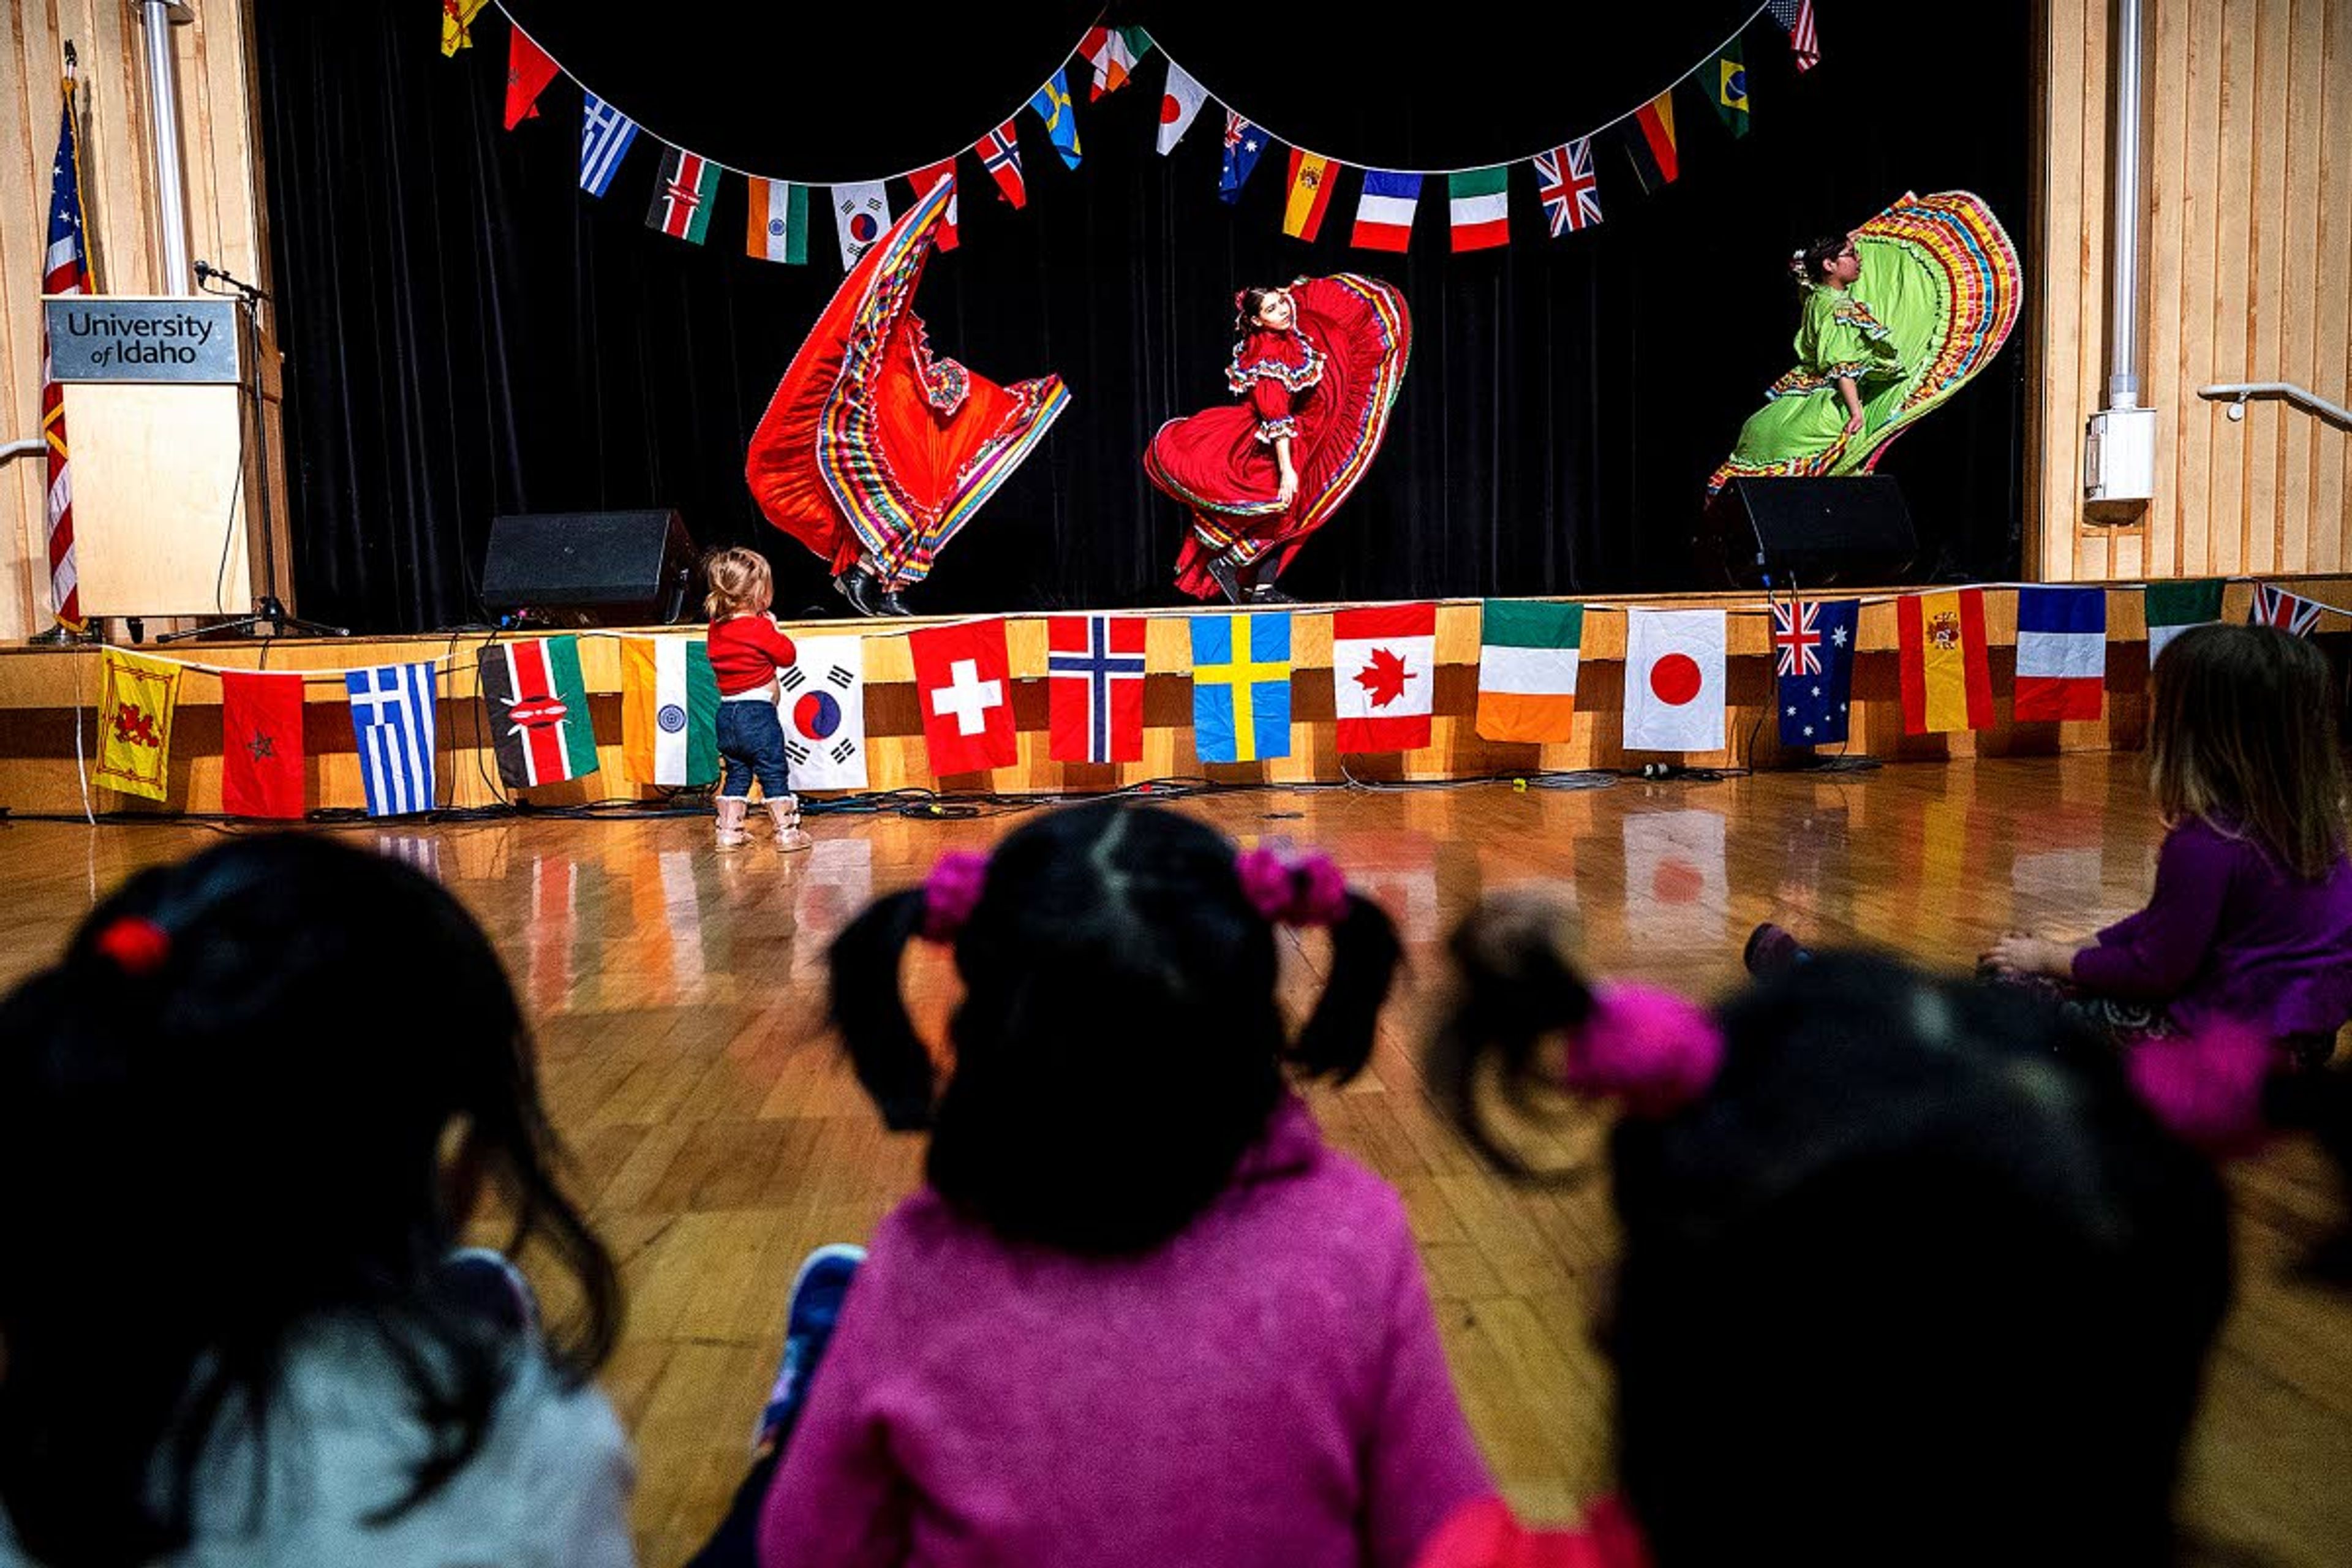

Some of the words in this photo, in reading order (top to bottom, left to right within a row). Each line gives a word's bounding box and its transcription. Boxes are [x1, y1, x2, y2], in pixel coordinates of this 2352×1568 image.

[68, 312, 213, 345] University
[90, 347, 114, 368] of
[116, 340, 196, 364] Idaho
